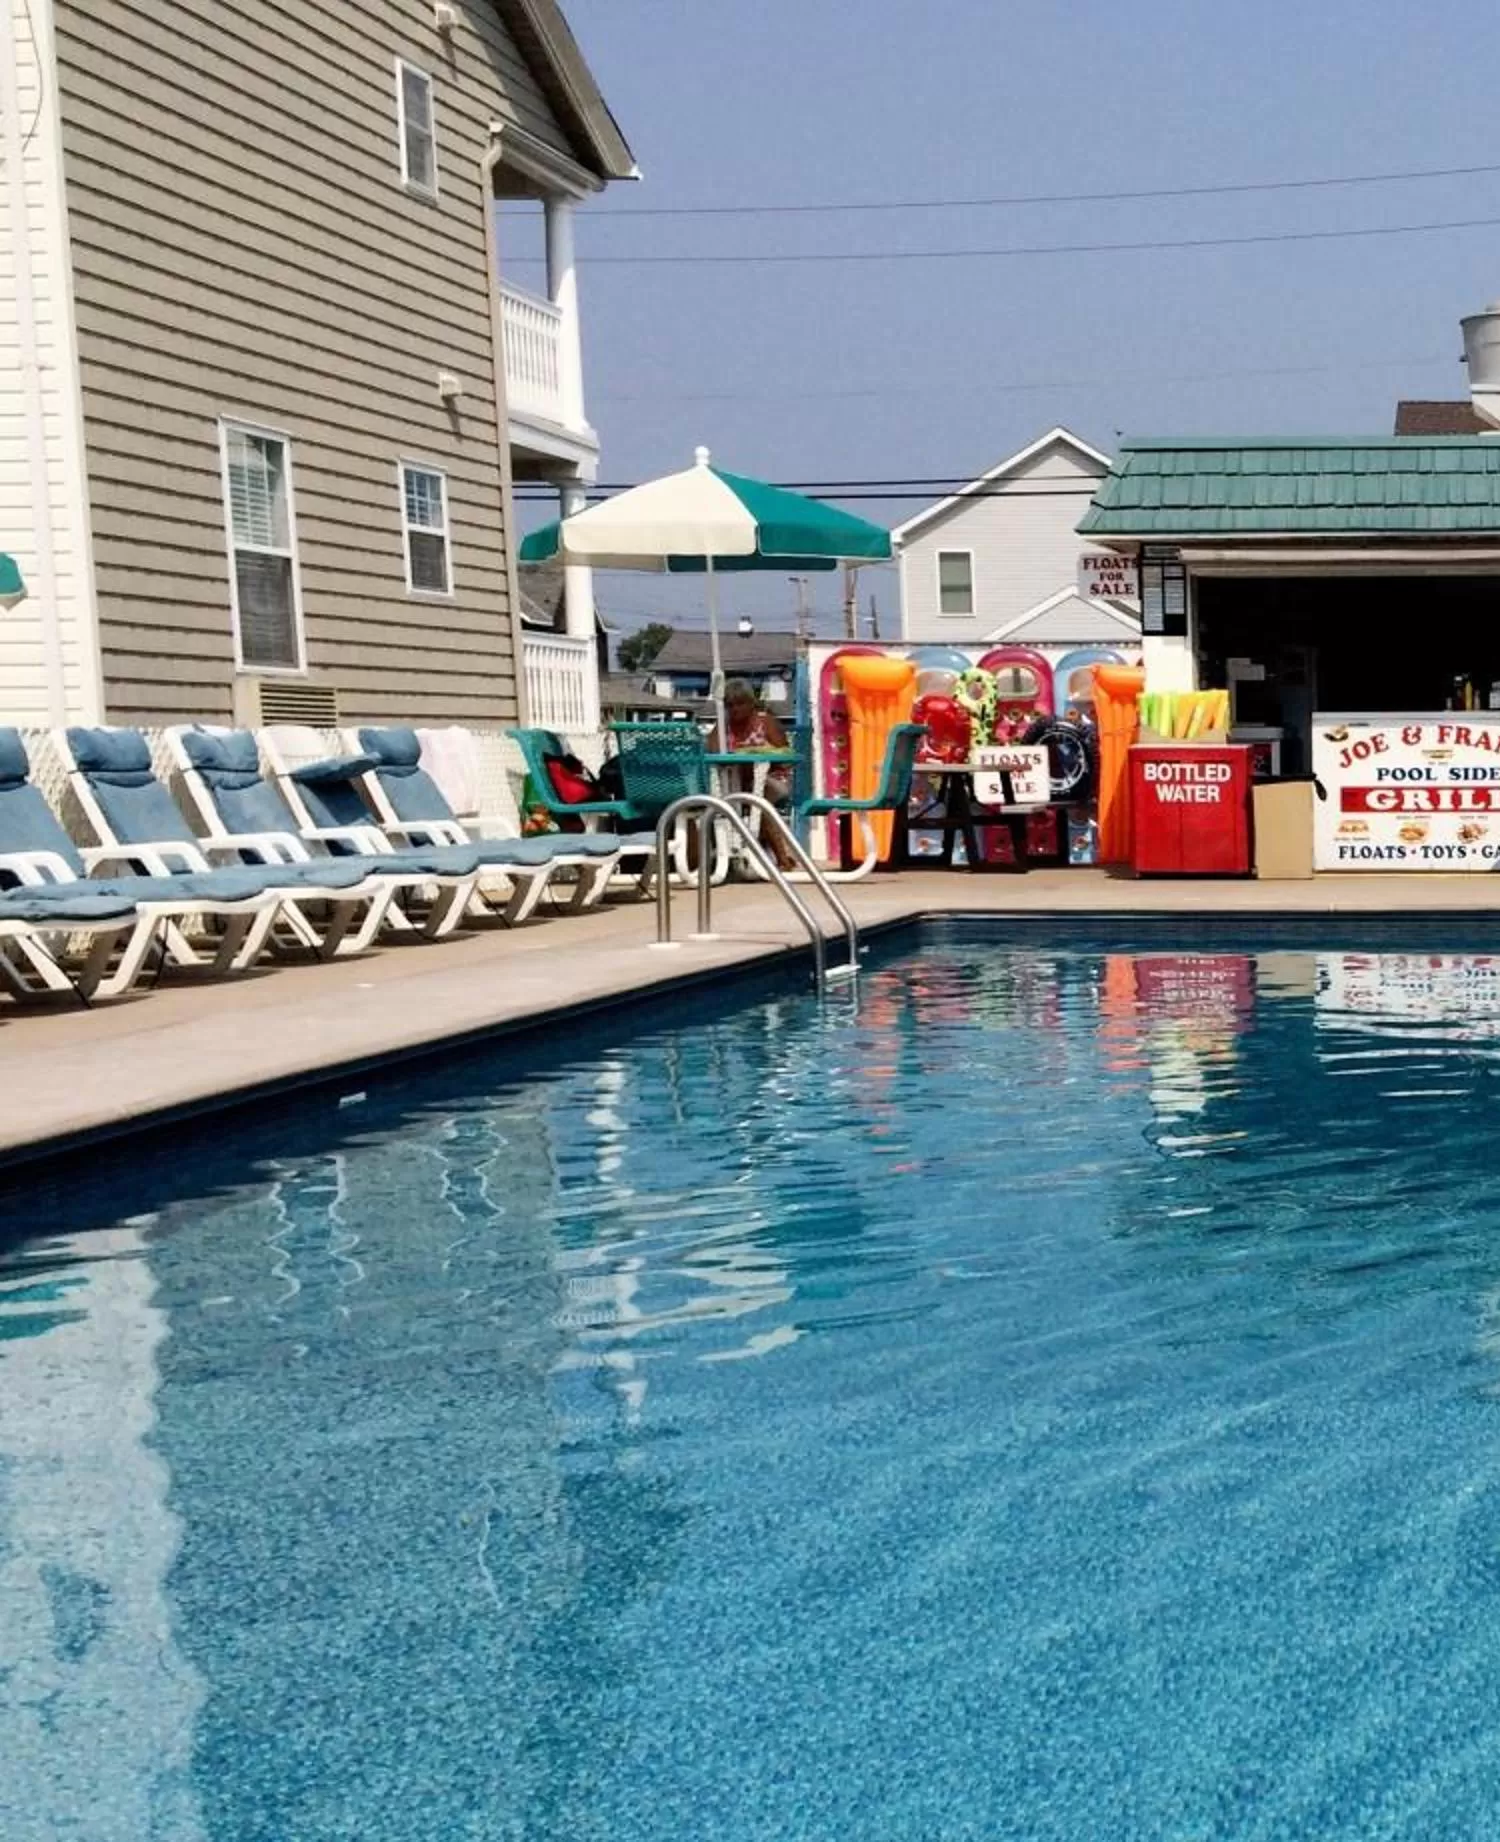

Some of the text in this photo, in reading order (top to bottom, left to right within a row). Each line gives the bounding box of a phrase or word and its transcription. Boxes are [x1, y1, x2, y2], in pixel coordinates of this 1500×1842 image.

[1082, 557, 1140, 570] FLOATS
[1099, 571, 1125, 582] FOR
[1089, 583, 1135, 595] SALE
[1338, 732, 1391, 769] JOE
[1402, 724, 1423, 745] &
[1143, 763, 1231, 782] BOTTLED
[1376, 767, 1437, 781] POOL
[988, 782, 1037, 794] SLE
[1155, 784, 1221, 802] WATER
[1338, 845, 1406, 859] FLOATS
[1422, 845, 1467, 859] TOYS
